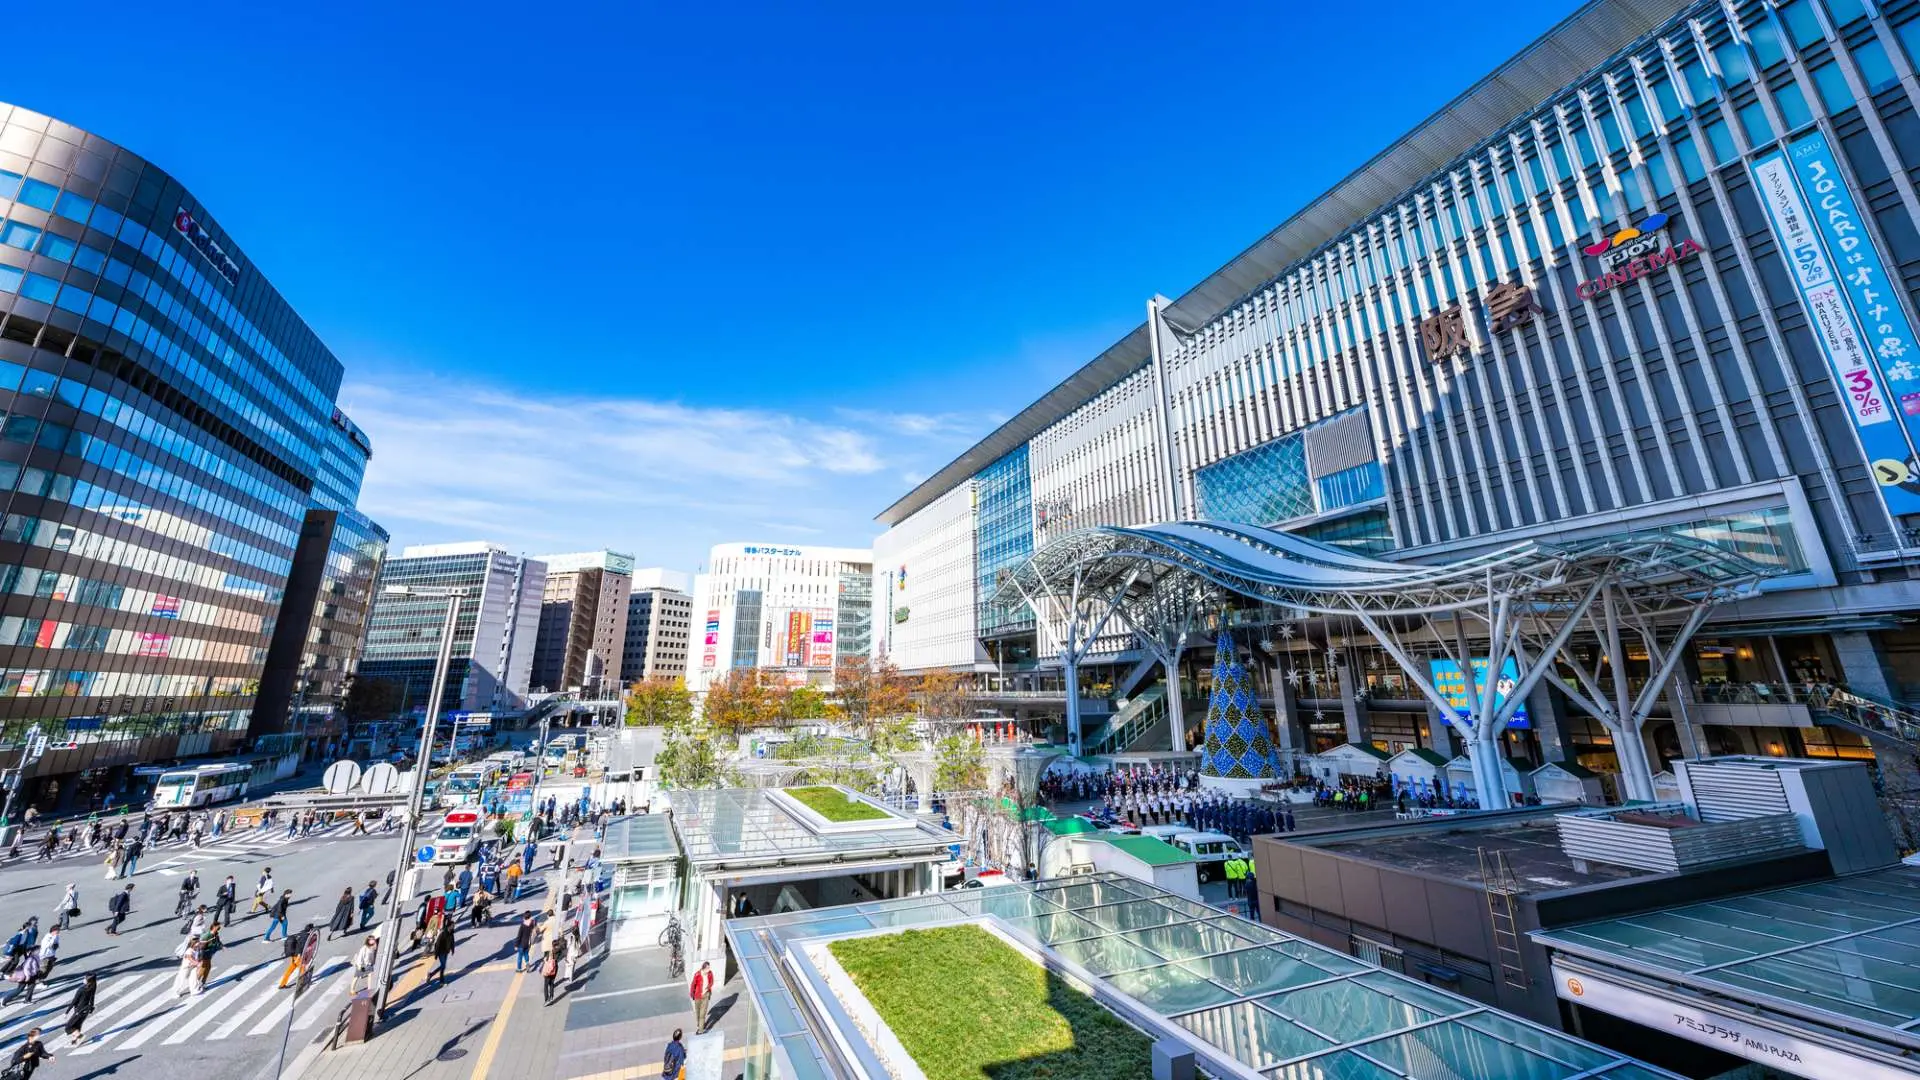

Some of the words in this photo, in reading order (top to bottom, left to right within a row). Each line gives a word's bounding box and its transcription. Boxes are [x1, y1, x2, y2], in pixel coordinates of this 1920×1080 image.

[1796, 142, 1821, 157] AMU
[1575, 238, 1704, 300] CINEMA
[1420, 281, 1543, 365] 阪急
[1815, 302, 1840, 345] MARUZEN
[1860, 405, 1881, 416] OFF
[743, 546, 802, 557] 博多バスターミナル
[1673, 1013, 1741, 1043] アミュプラザ
[1744, 1038, 1769, 1053] AMU
[1770, 1046, 1802, 1063] PLAZA
